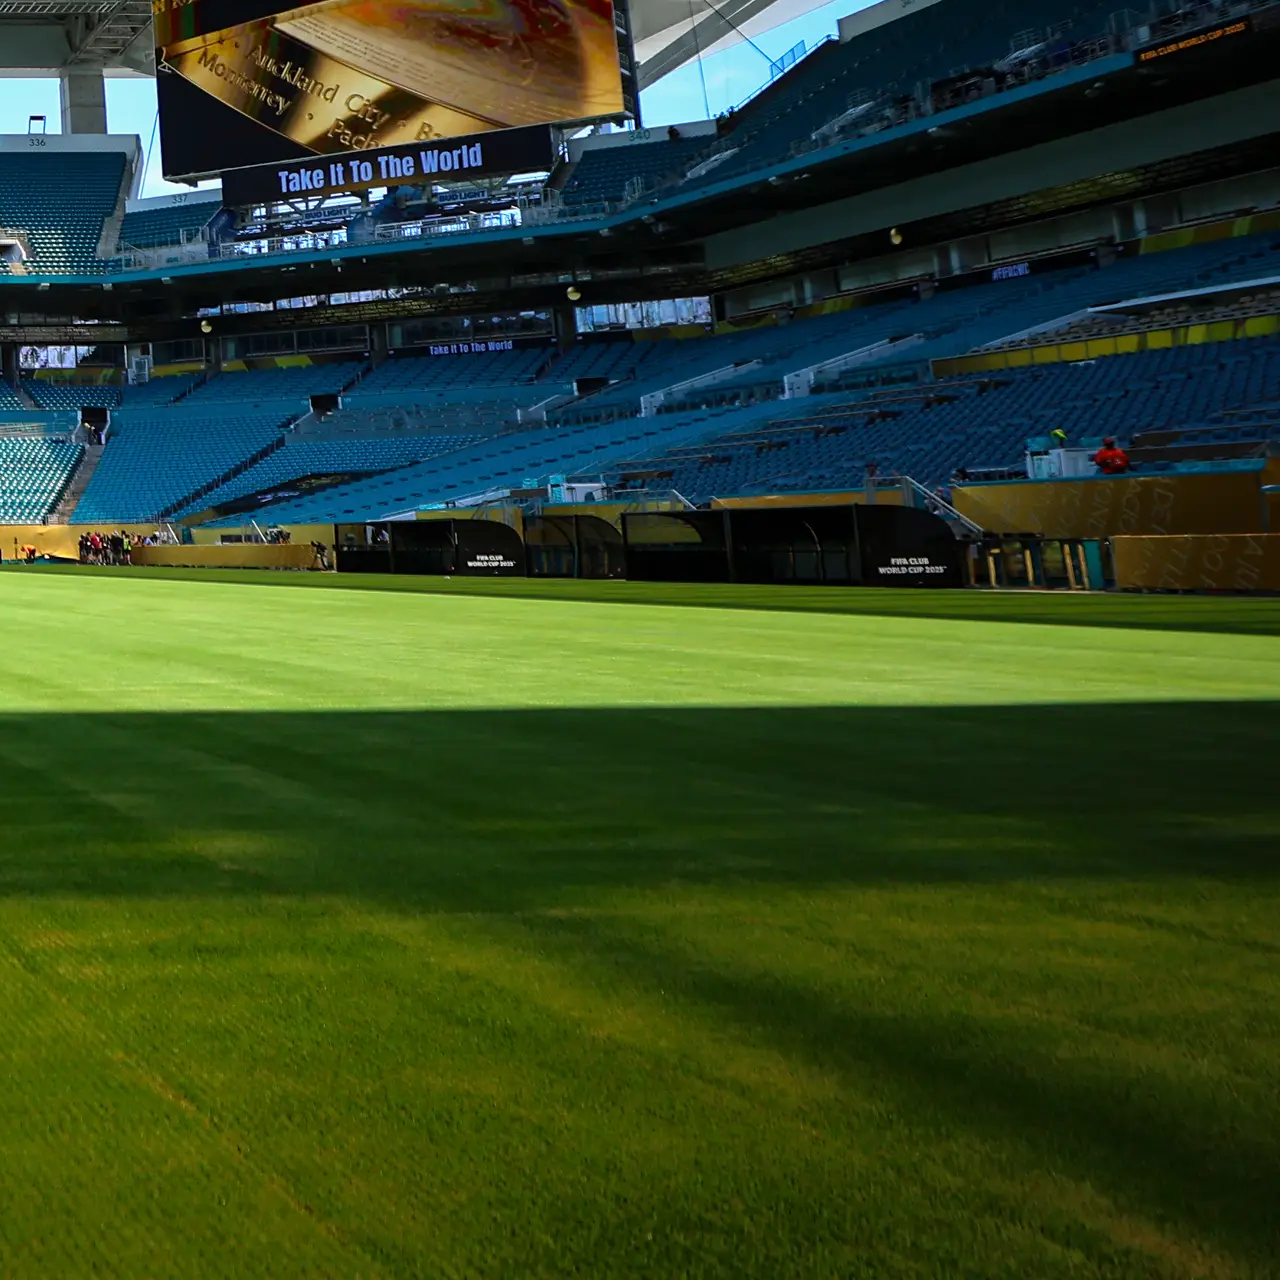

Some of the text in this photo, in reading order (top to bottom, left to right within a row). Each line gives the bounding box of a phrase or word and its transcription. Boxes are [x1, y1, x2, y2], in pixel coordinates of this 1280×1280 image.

[1139, 50, 1157, 61] FIFA
[1157, 43, 1178, 56] CLUB
[1178, 34, 1207, 49] WORLD
[1207, 29, 1224, 40] CUP
[197, 46, 293, 116] Monterrey
[246, 44, 391, 130] Auckland City
[29, 137, 46, 147] 336
[278, 142, 483, 193] Take It To The World
[171, 194, 188, 204] 337
[459, 189, 486, 200] LIGHT
[304, 207, 349, 220] BUD LIGHT
[429, 340, 513, 356] Take It To The World
[890, 557, 930, 565] FIFA CLUB
[877, 566, 908, 574] WORLD
[908, 566, 924, 574] CUP
